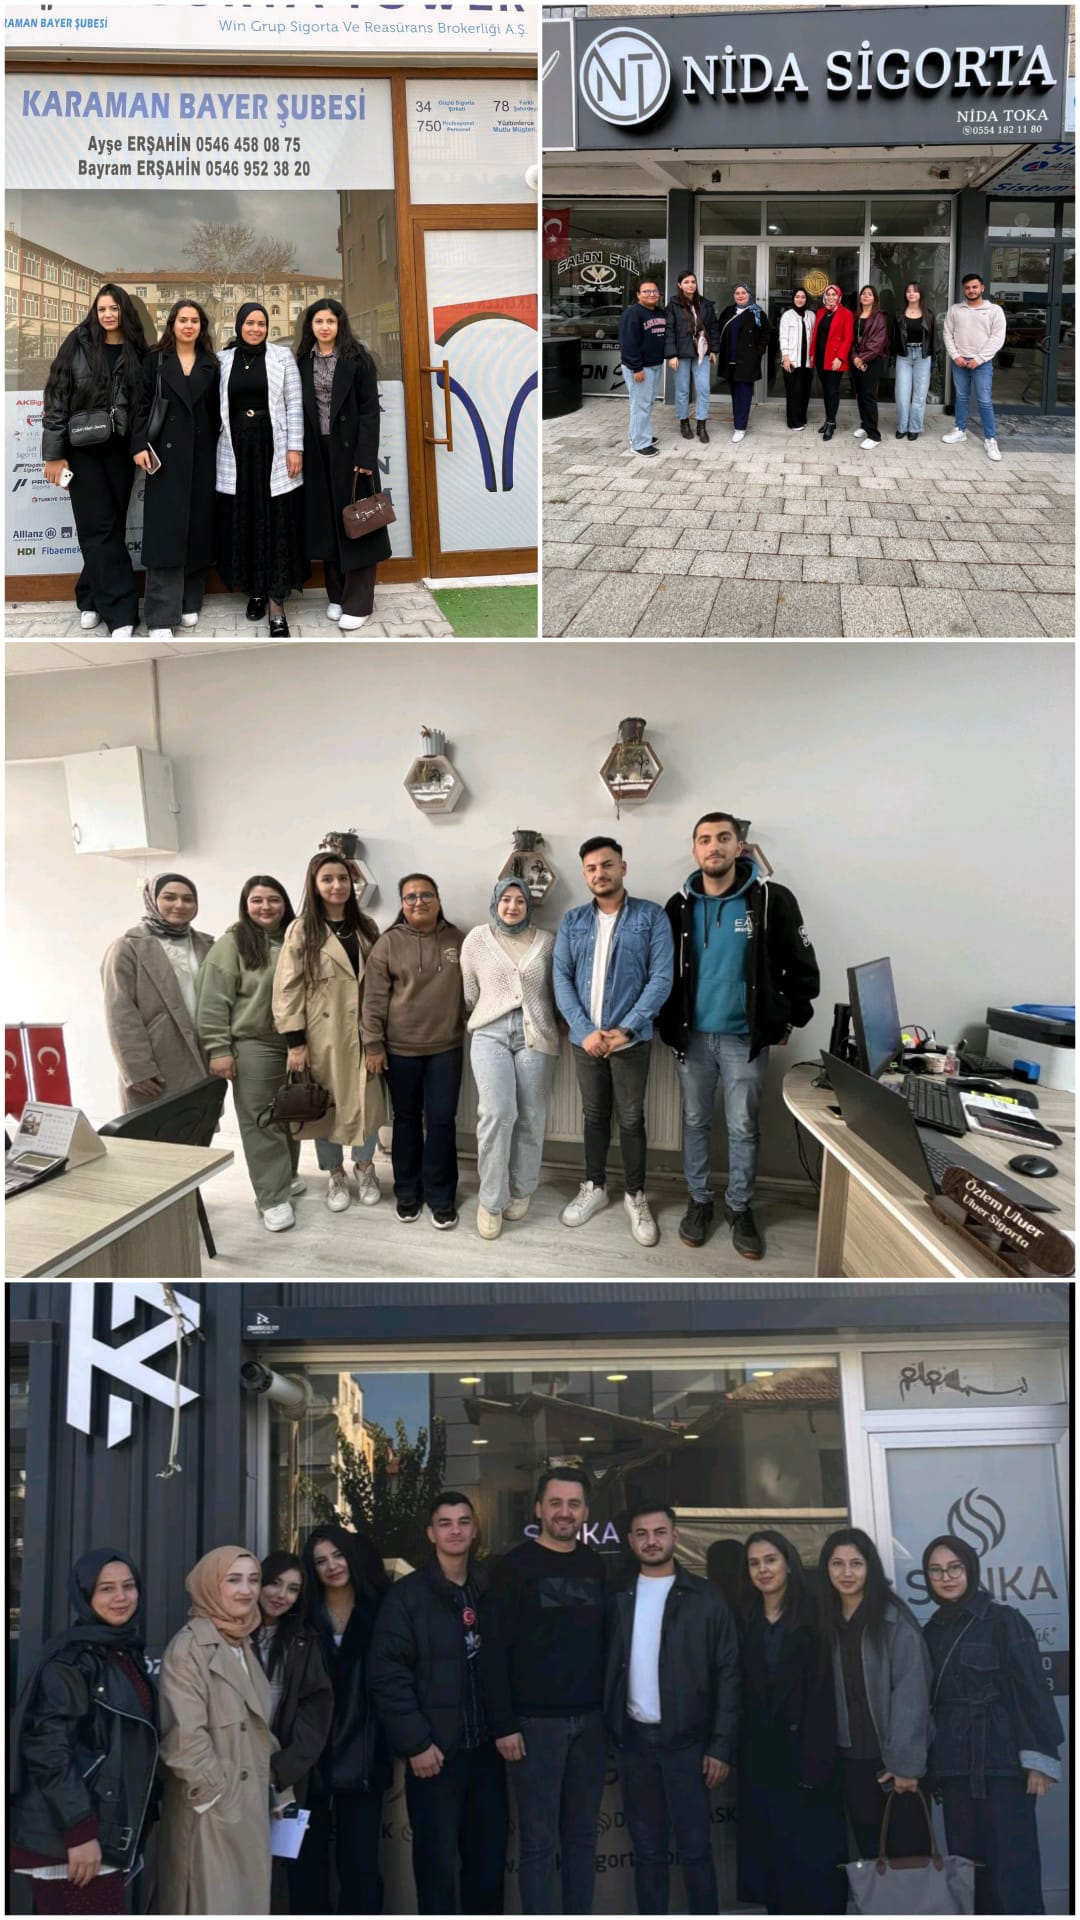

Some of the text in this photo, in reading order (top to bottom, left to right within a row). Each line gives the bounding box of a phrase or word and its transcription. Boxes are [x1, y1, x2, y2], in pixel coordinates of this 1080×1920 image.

[41, 18, 72, 28] BAYER
[75, 16, 108, 31] ŞUBESİ
[219, 20, 246, 32] Win
[251, 20, 286, 36] Grup
[290, 21, 339, 35] Sigorta
[343, 21, 360, 33] Ve
[438, 22, 501, 36] Brokerliği
[505, 24, 529, 37] A.Ş.
[682, 40, 1058, 96] NİDA SİGORTA
[22, 87, 366, 129] KARAMAN BAYER ŞUBESİ
[415, 100, 432, 112] 34
[493, 100, 510, 112] 78
[956, 108, 1049, 123] NİDA TOKA
[416, 120, 442, 132] 750
[972, 125, 1042, 135] 0554 182 11 80
[88, 132, 301, 155] Ayşe ERŞAHİN 0546 458 08 75
[78, 156, 310, 179] Bayram ERŞAHİN 0546 952 38 20
[557, 251, 640, 276] SALON STİL
[13, 530, 44, 539] Allianz
[17, 545, 81, 556] HDI Fibaemek
[964, 1178, 1045, 1238] Özlem Uluer
[962, 1194, 1030, 1249] Uluer Sigorta
[523, 1521, 620, 1545] SKA
